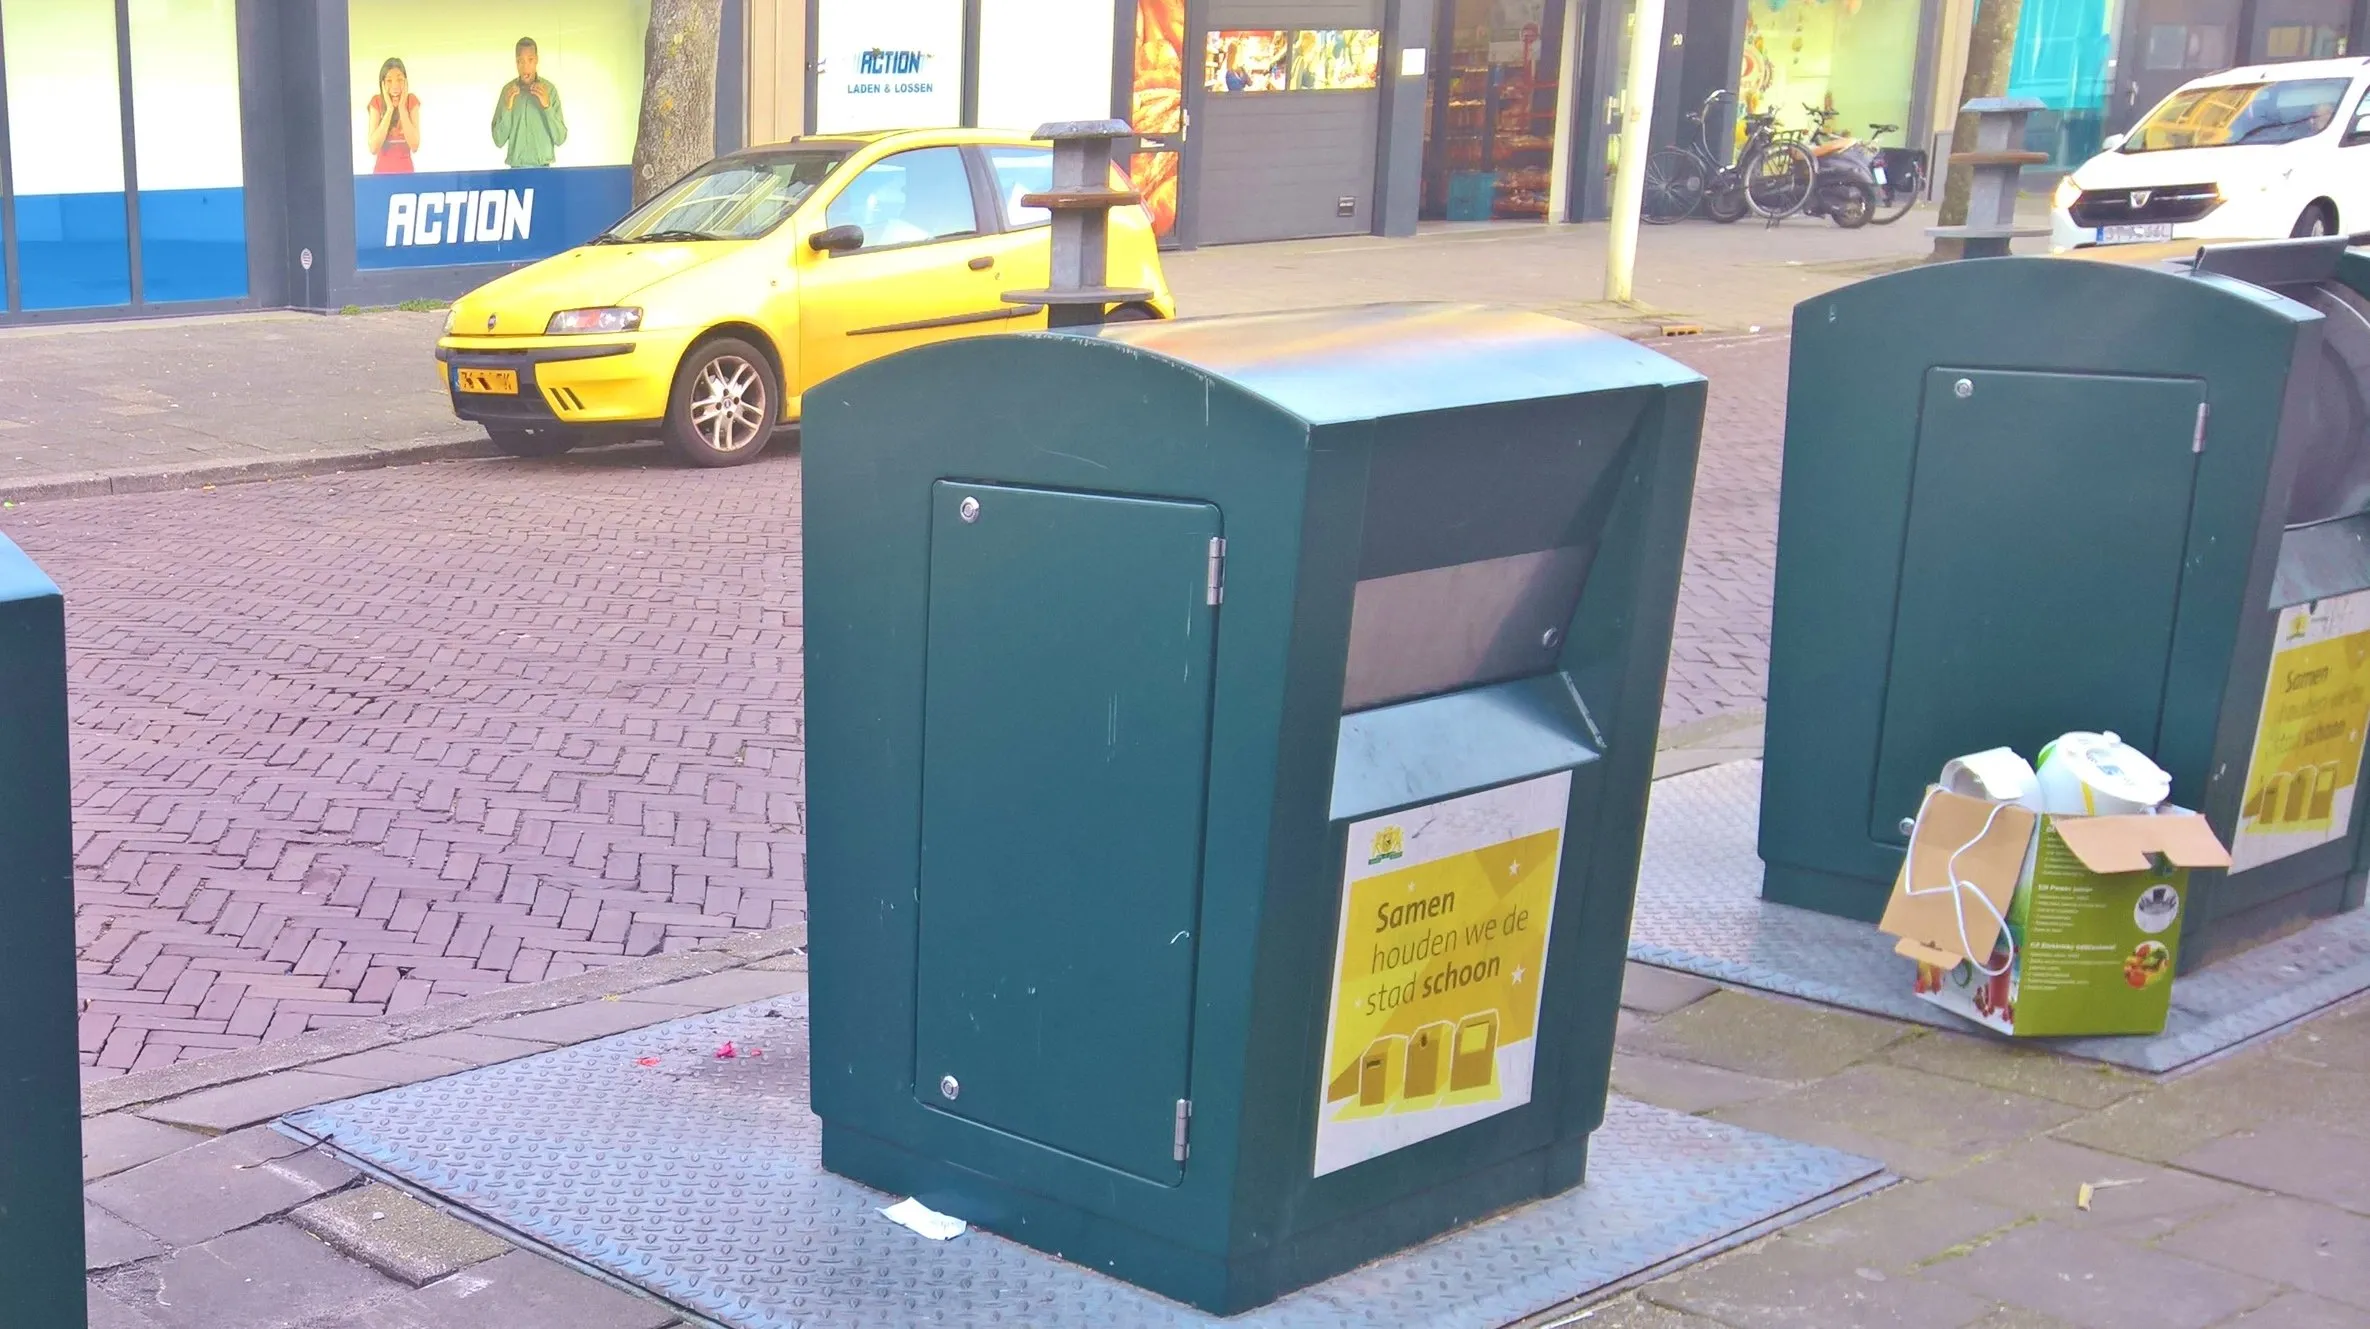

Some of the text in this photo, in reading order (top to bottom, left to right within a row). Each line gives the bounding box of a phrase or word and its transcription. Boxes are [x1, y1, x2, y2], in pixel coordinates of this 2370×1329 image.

[860, 50, 921, 74] ACTION
[847, 83, 933, 94] LADEN & LOSSEN
[385, 188, 535, 247] ACTION
[1375, 890, 1456, 934] Samen
[1371, 903, 1529, 975] houden we de
[1366, 955, 1501, 1016] stad schoon
